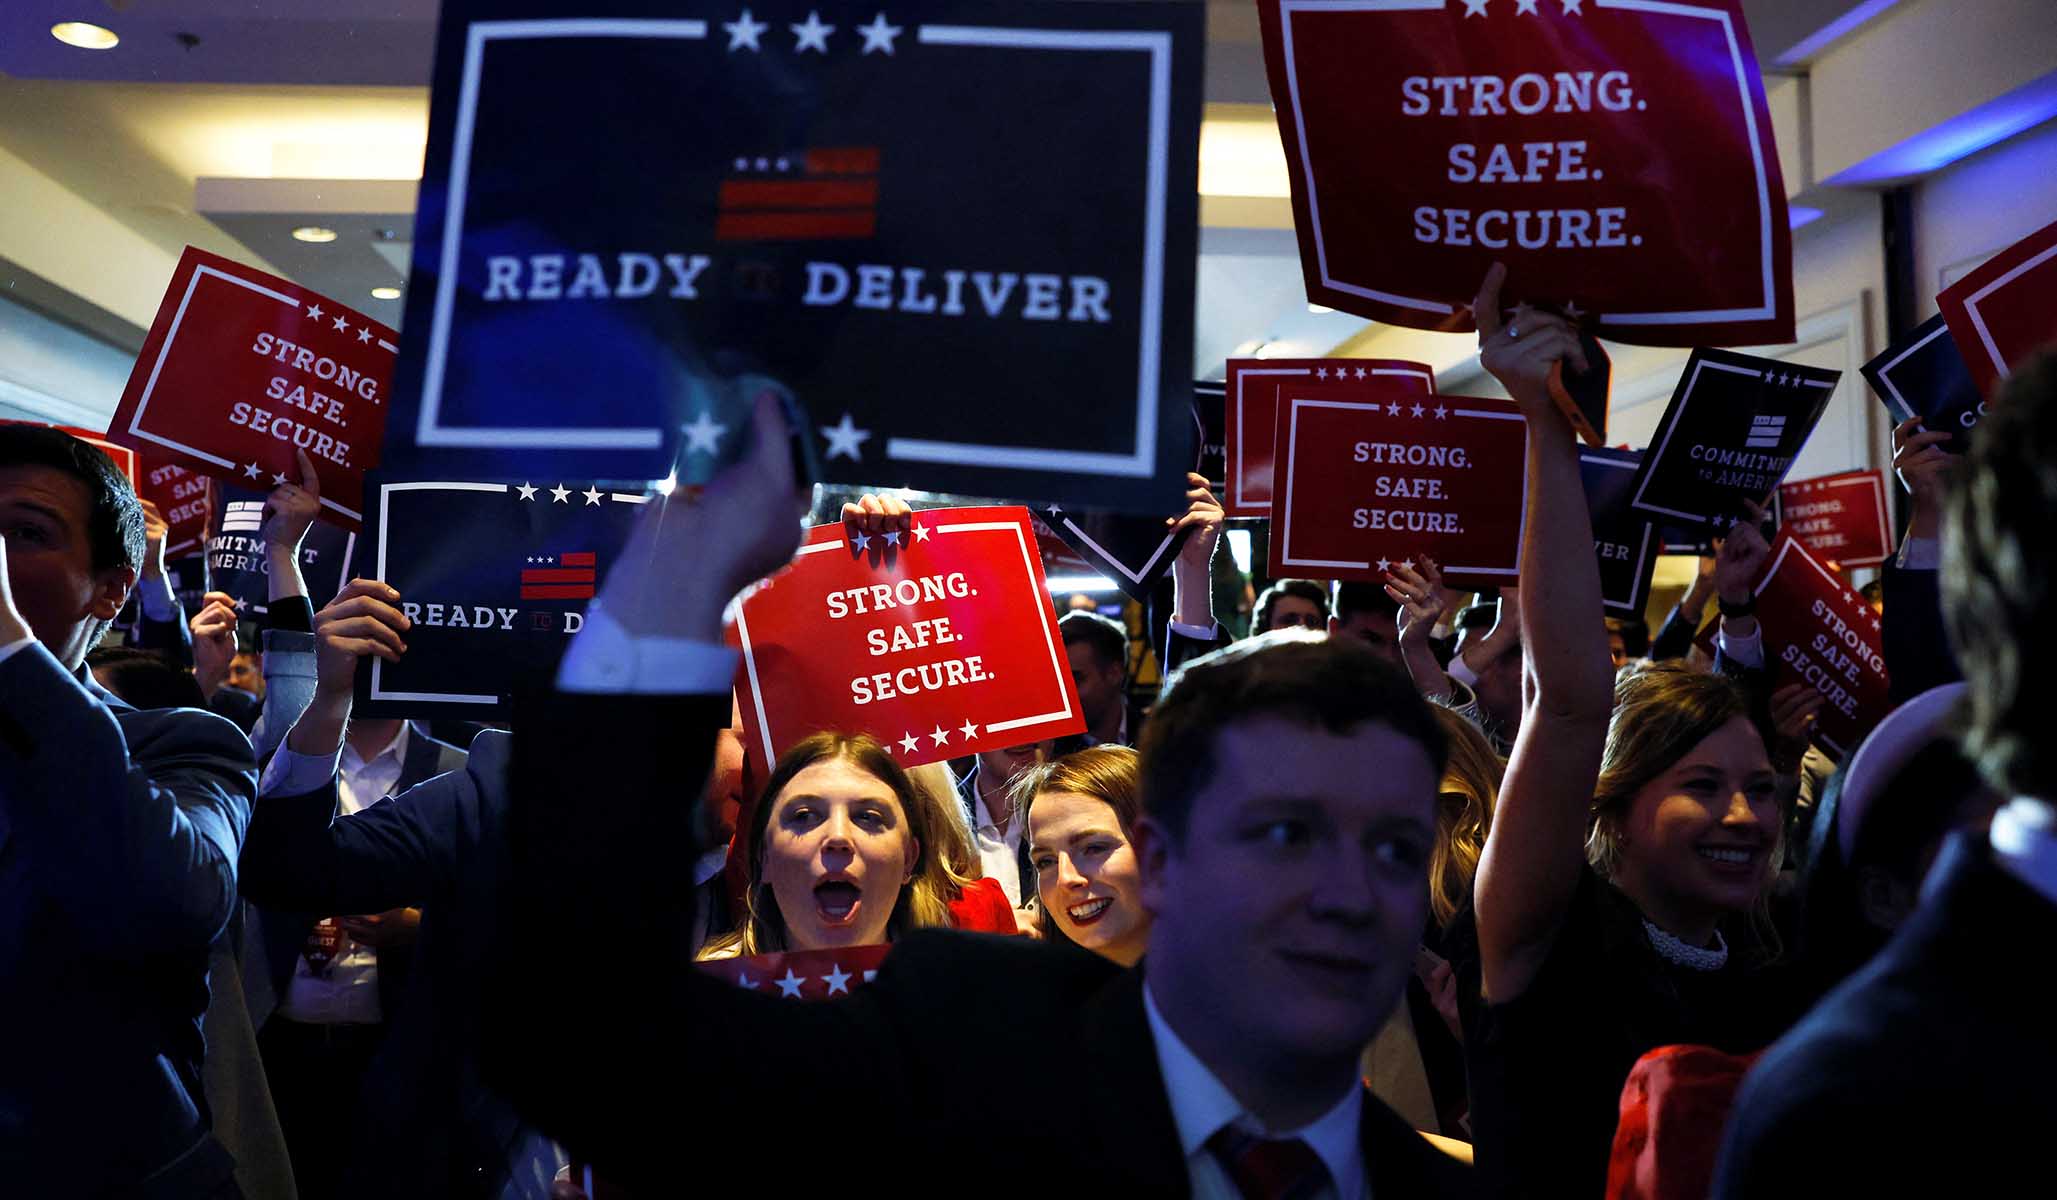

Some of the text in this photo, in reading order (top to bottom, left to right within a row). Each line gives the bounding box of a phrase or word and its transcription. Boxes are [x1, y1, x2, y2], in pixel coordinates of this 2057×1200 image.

[1402, 71, 1647, 116] STRONG.
[1448, 141, 1603, 182] SAFE.
[1414, 206, 1642, 249] SECURE.
[483, 253, 710, 301] READY
[802, 261, 1111, 322] DELIVER
[253, 332, 380, 405] STRONG.
[266, 376, 347, 427] SAFE.
[229, 401, 351, 468] SECURE.
[1354, 441, 1472, 469] STRONG.
[1375, 475, 1448, 500] SAFE.
[1353, 508, 1465, 534] SECURE.
[403, 602, 518, 630] READY
[826, 572, 978, 619] STRONG.
[867, 617, 963, 656] SAFE.
[1811, 599, 1886, 678] STRONG.
[1812, 634, 1860, 686] SAFE.
[851, 656, 995, 705] SECURE.
[1781, 644, 1857, 719] SECURE.
